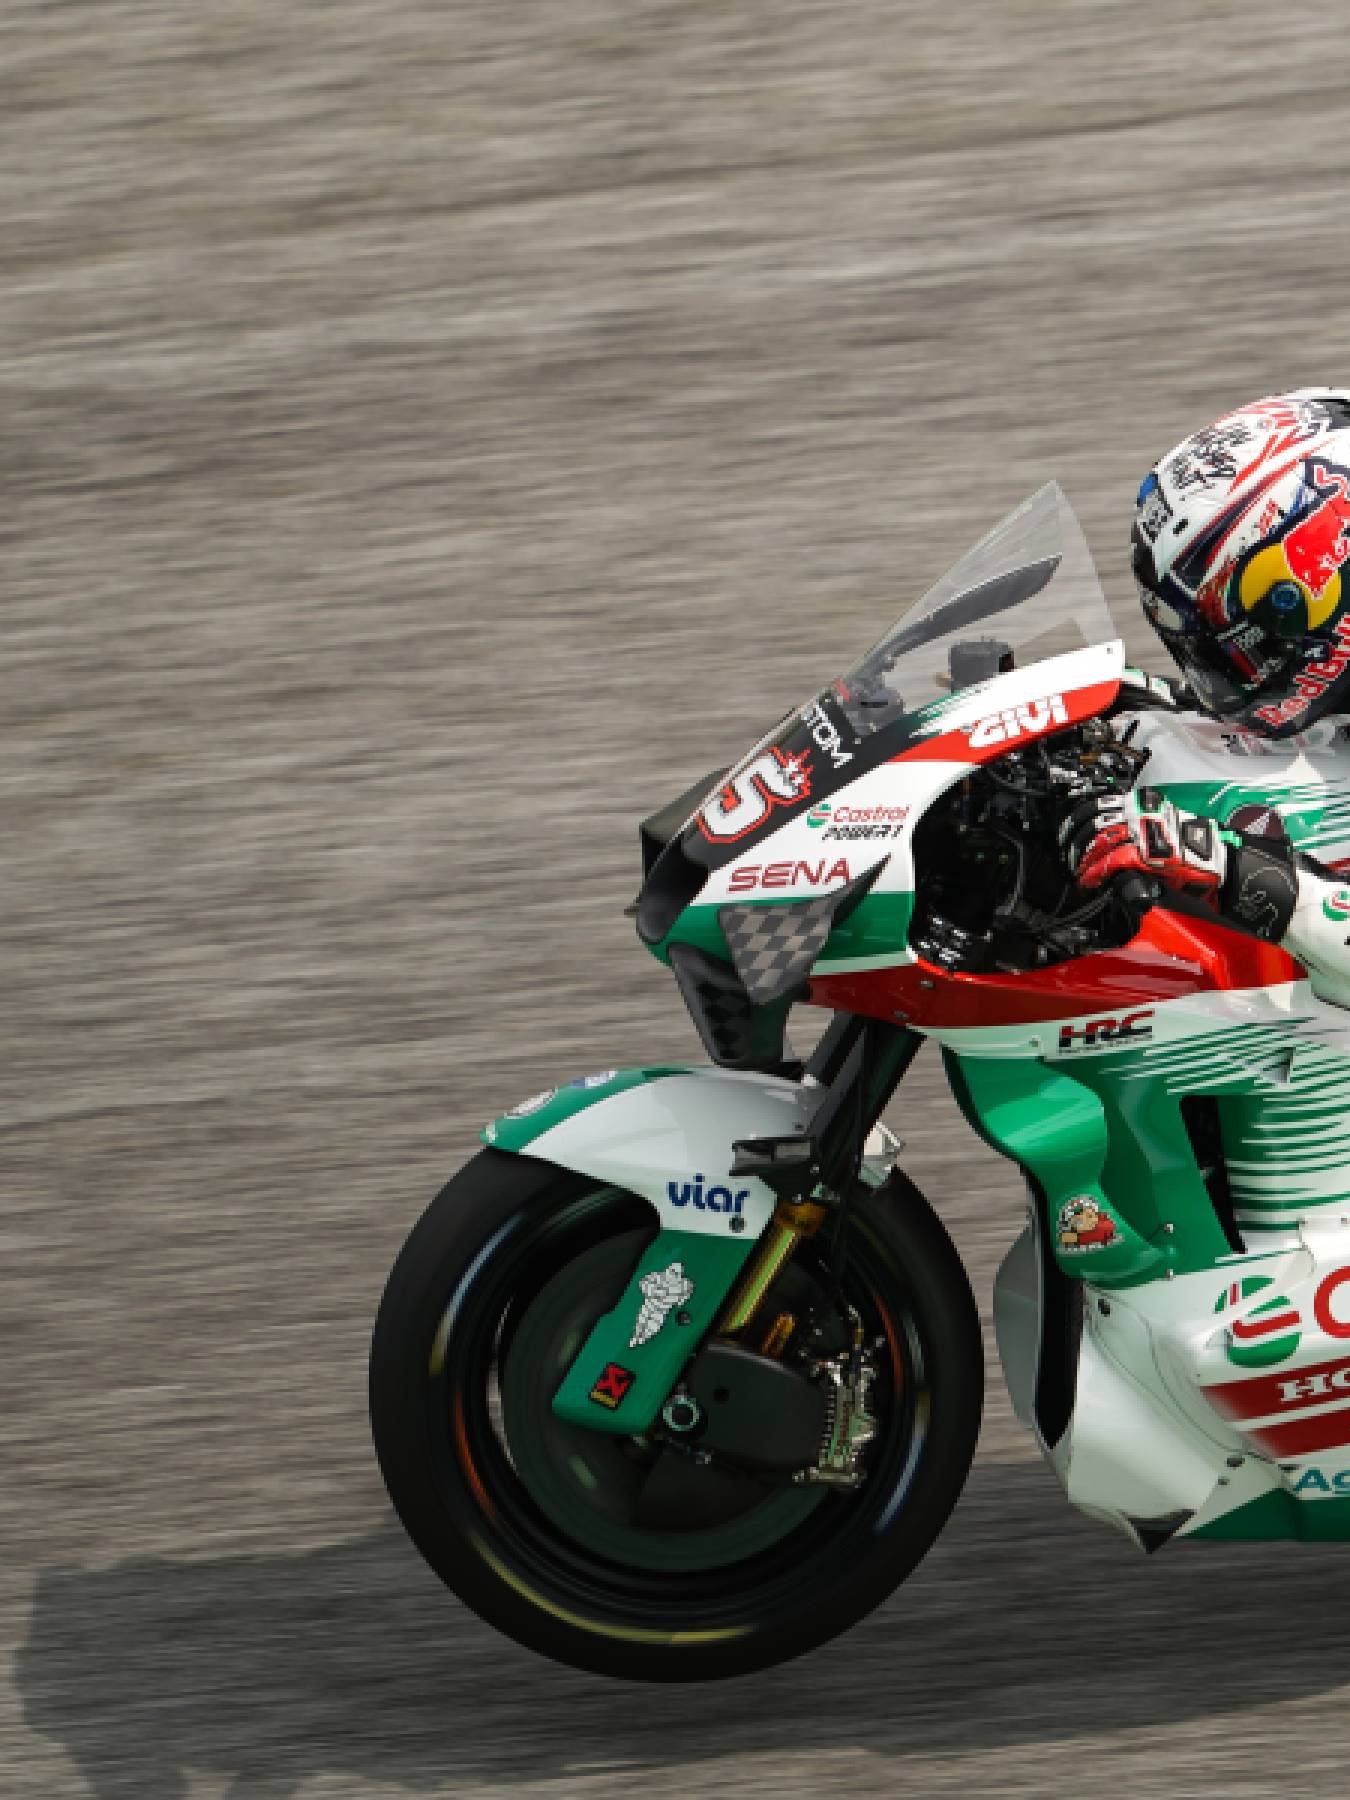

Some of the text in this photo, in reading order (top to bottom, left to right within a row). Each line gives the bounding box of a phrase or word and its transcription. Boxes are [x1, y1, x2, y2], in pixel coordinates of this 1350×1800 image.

[968, 694, 1069, 748] GIVI
[699, 747, 814, 844] 5
[832, 804, 911, 824] Castrol
[821, 824, 903, 842] POWER1
[728, 857, 851, 893] SENA
[1058, 1009, 1155, 1048] HRC
[667, 1174, 751, 1214] viar
